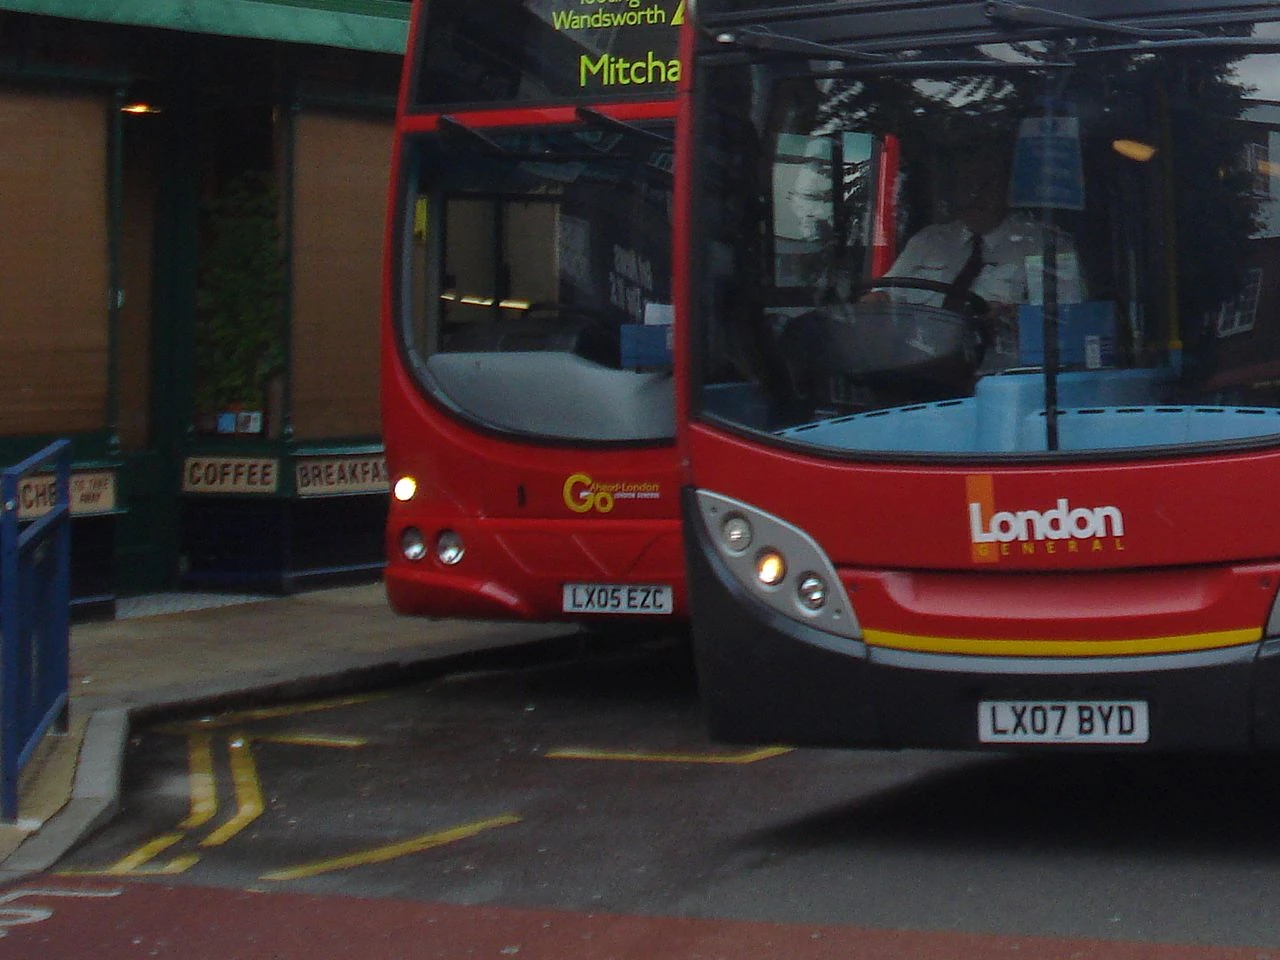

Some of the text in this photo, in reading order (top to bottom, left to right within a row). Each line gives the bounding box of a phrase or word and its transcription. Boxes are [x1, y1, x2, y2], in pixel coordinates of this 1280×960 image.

[552, 4, 666, 31] Wandsworth
[189, 462, 274, 487] COFFEE
[562, 472, 615, 514] Go
[968, 498, 1125, 544] London
[975, 538, 1125, 557] GENERAL
[571, 587, 664, 611] LX05 EZC
[991, 704, 1136, 736] LX07 BYD
